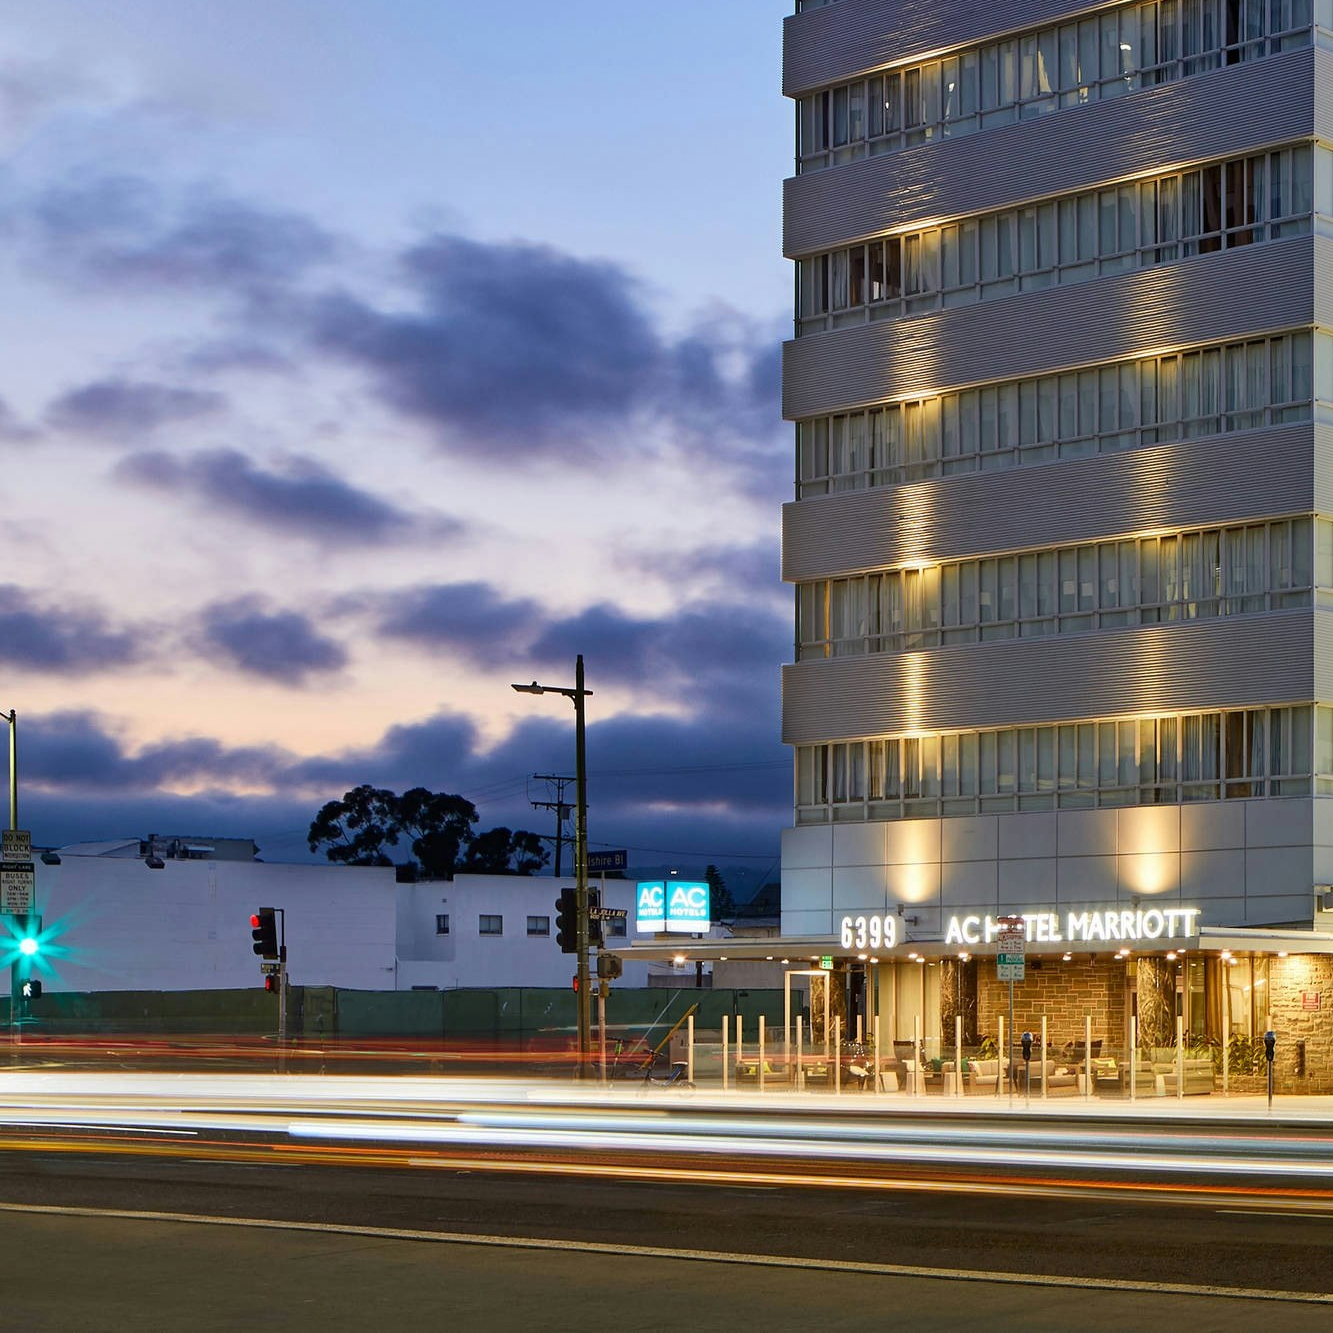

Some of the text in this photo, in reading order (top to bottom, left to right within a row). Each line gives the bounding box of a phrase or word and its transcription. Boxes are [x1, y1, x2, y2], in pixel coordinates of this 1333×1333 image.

[4, 844, 30, 852] BLOCK
[588, 855, 612, 866] lshire
[638, 886, 663, 908] AC
[669, 886, 707, 908] AC
[638, 908, 664, 916] HOTELS
[669, 908, 707, 917] HOTELS
[841, 915, 896, 949] 6399
[945, 915, 980, 944] AC
[984, 913, 1063, 944] HTEL
[1067, 909, 1202, 941] MARRIOTT
